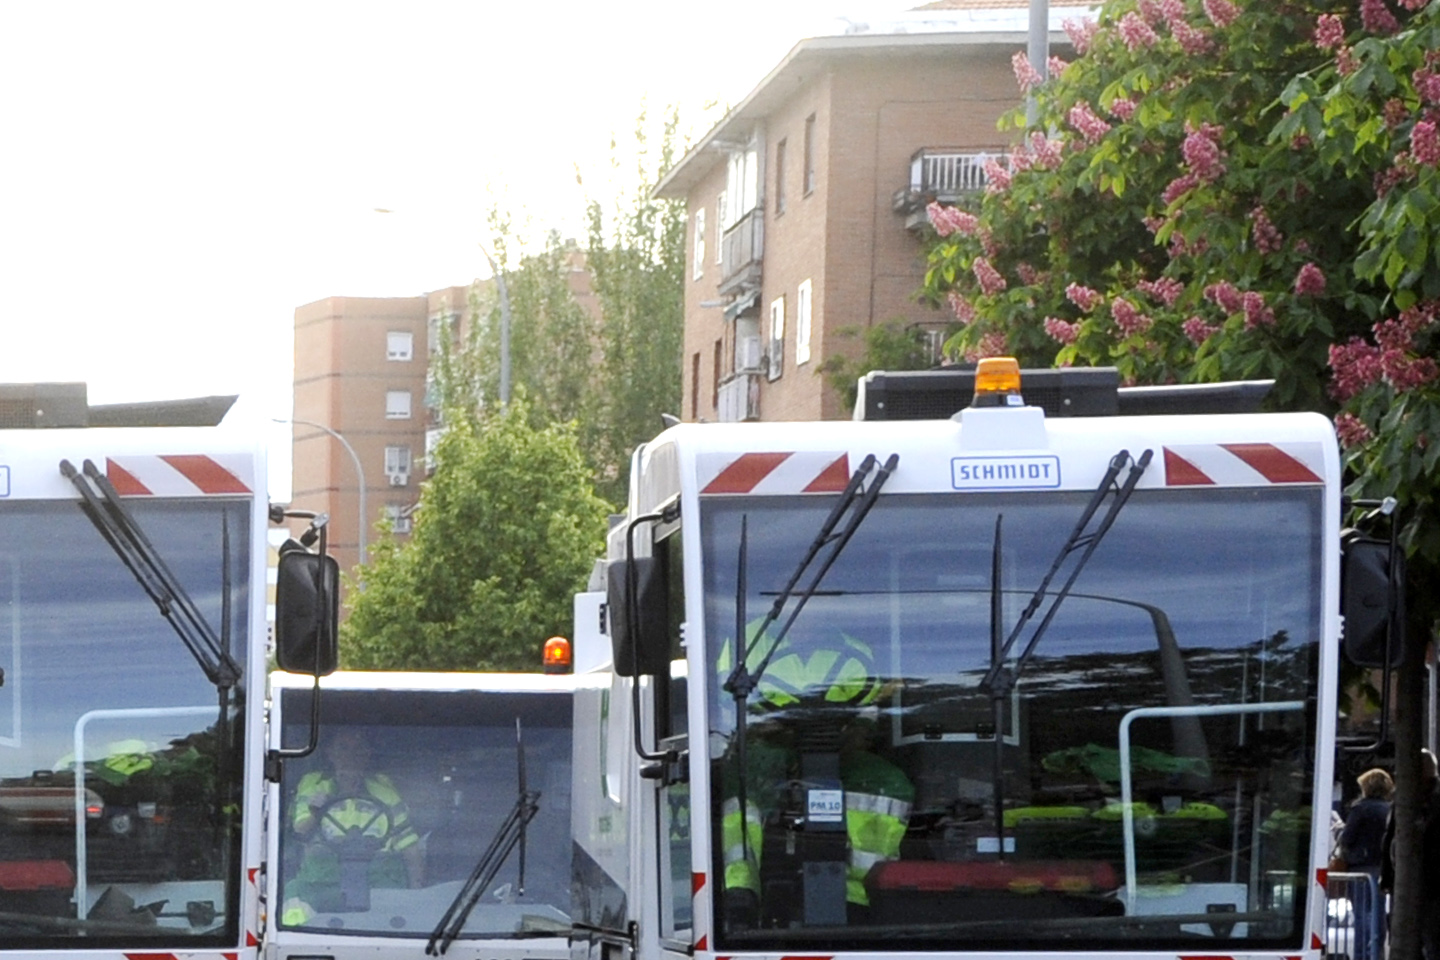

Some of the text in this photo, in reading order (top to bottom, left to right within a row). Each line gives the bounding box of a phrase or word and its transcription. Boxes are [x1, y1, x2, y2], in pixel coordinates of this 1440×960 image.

[960, 463, 1051, 480] SCHMIDT
[810, 801, 841, 810] PM 10
